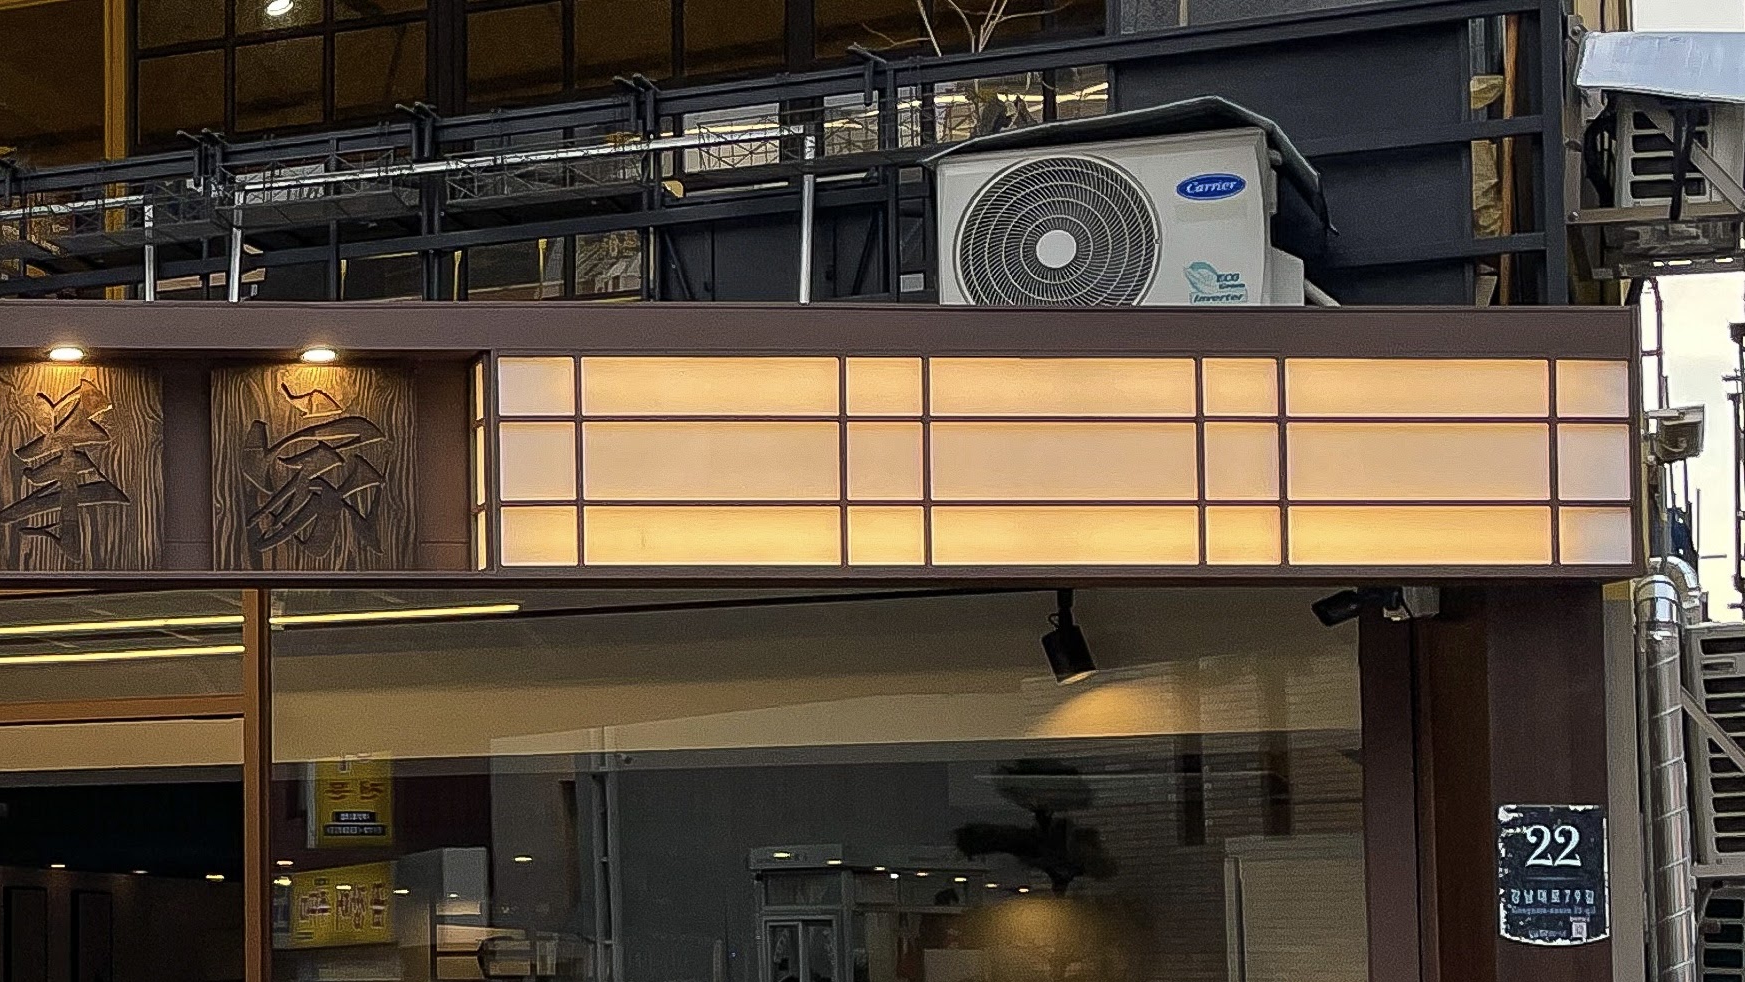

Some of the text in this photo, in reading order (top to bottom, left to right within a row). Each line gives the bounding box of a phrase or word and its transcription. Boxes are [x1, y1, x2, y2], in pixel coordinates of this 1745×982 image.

[1185, 179, 1238, 194] Carrier
[1193, 293, 1244, 303] Inverter
[1524, 824, 1582, 868] 22
